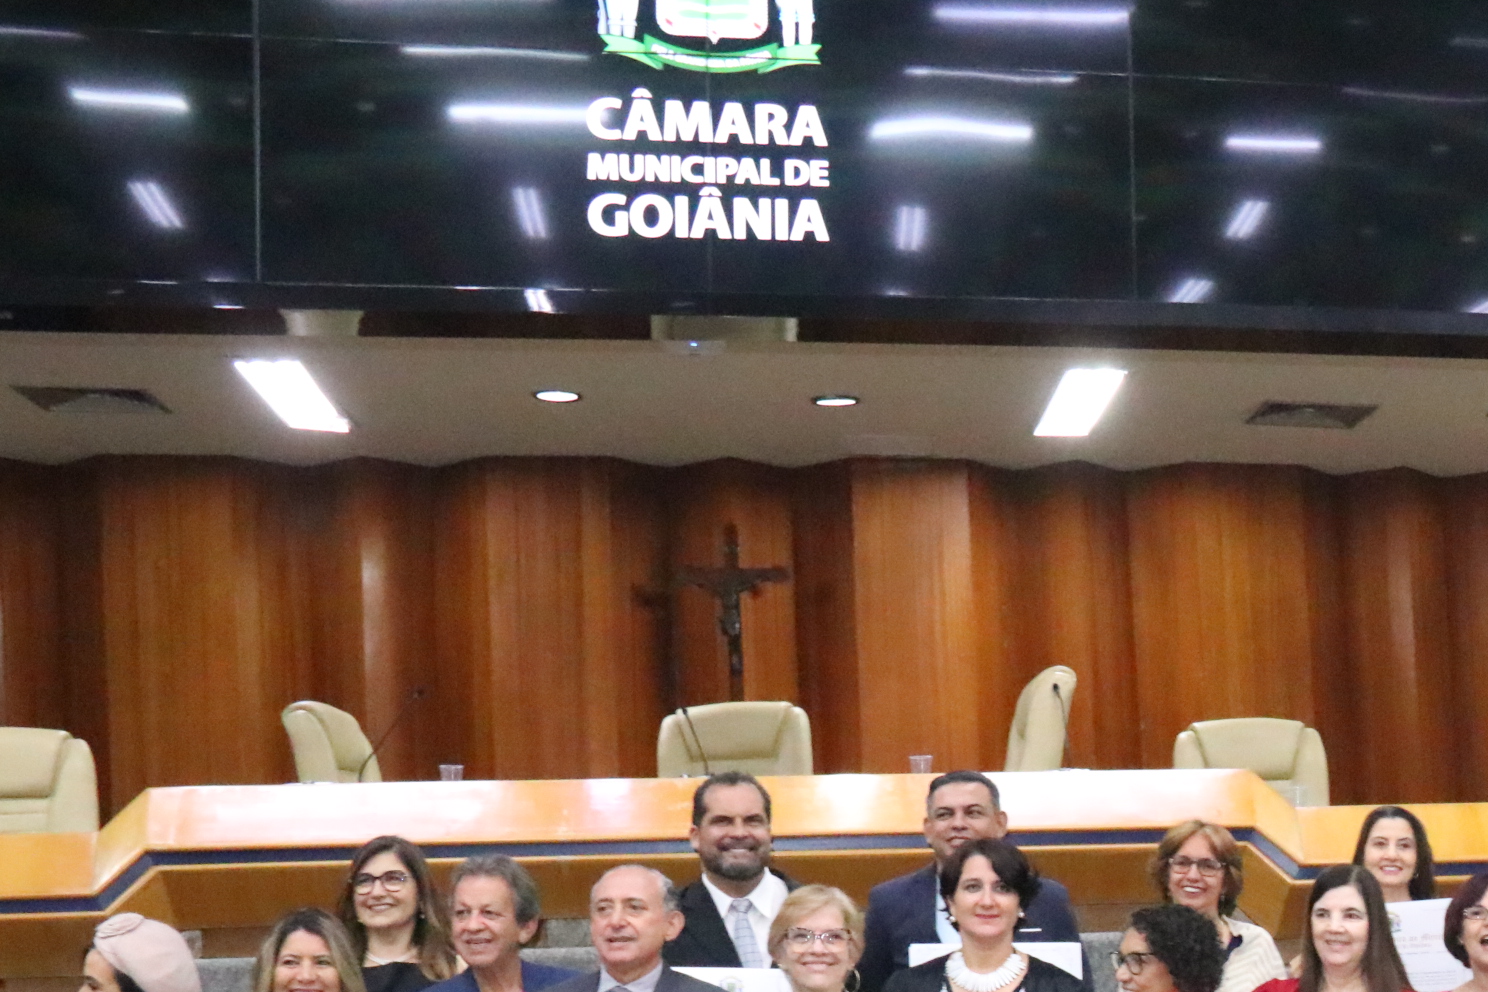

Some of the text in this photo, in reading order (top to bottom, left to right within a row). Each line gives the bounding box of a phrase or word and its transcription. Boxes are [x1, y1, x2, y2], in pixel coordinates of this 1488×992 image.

[586, 87, 828, 147] CÂMARA
[586, 152, 830, 187] MUNICIPAL DE
[587, 186, 830, 242] GOIÂNIA
